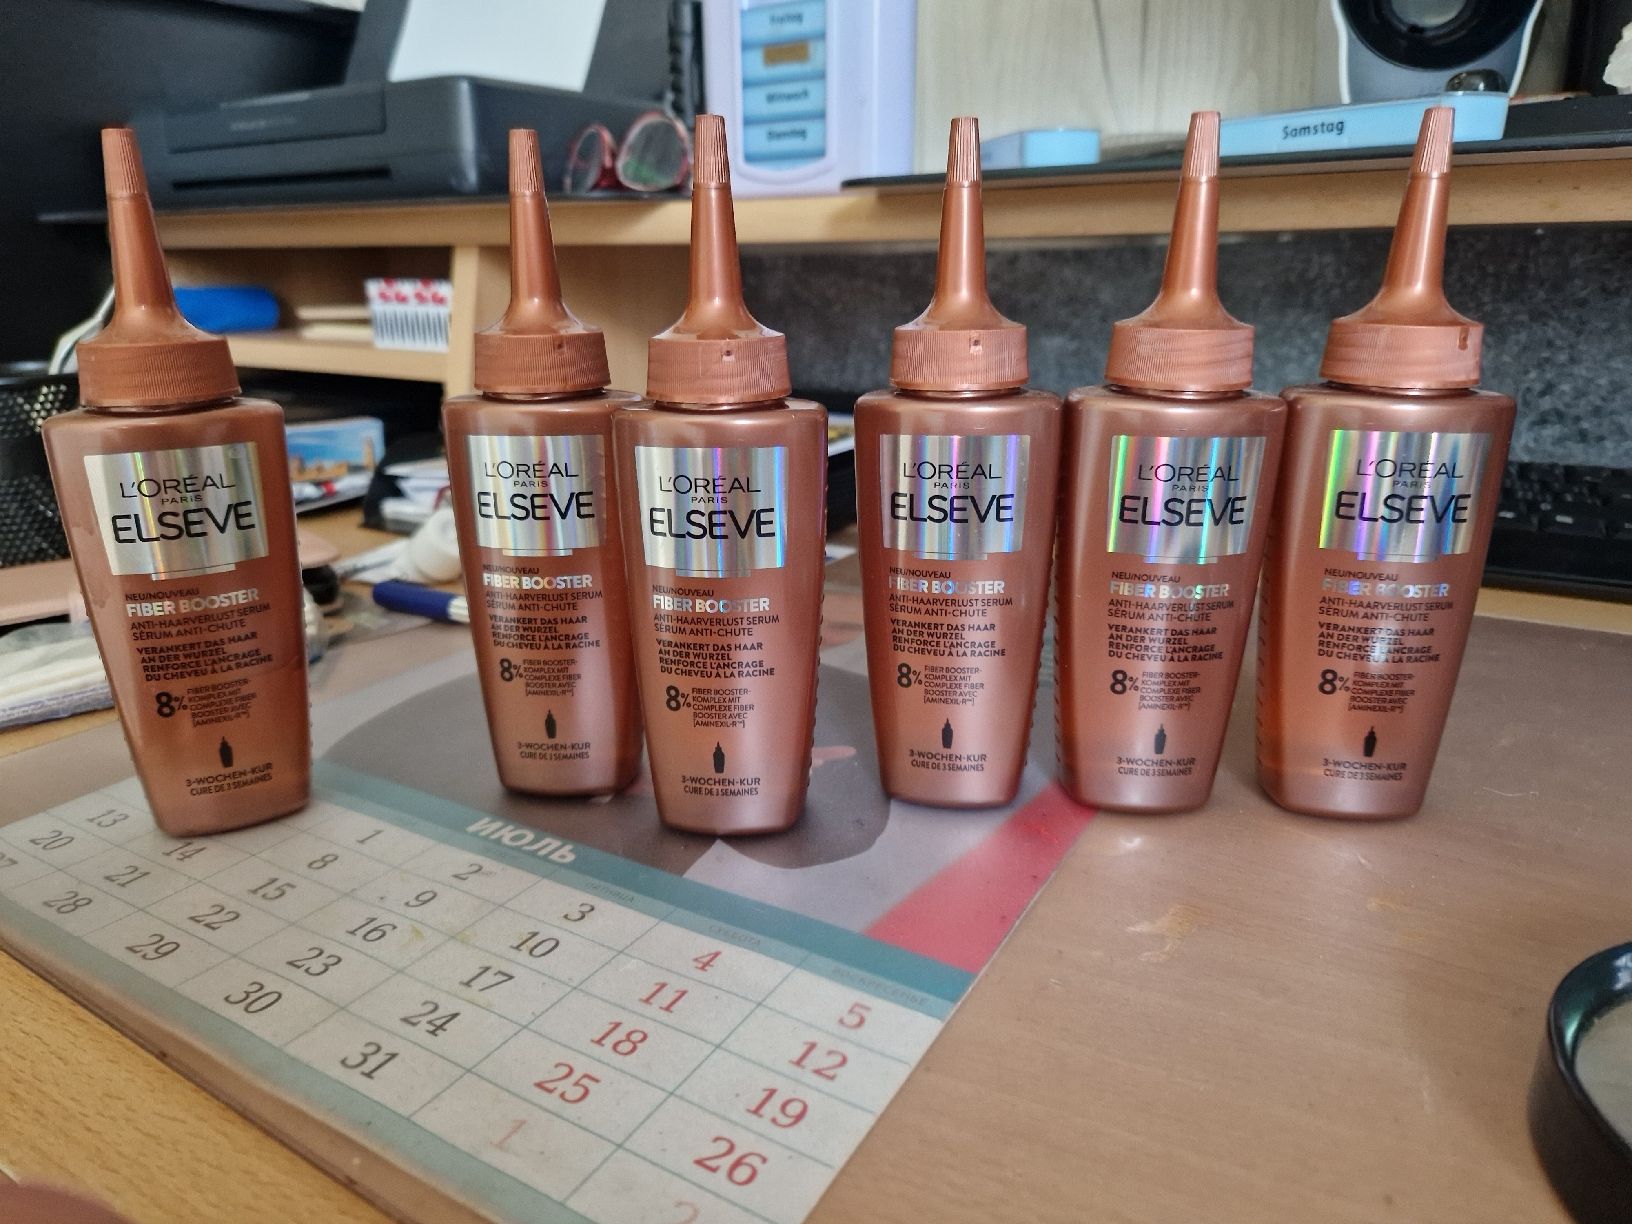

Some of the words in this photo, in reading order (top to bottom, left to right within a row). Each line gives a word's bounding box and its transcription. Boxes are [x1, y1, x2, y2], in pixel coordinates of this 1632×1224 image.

[1281, 120, 1345, 140] Samstag
[485, 457, 579, 480] L'ORÉAL
[903, 462, 1002, 479] L'ORÉAL
[1138, 463, 1239, 482] L'ORÉAL
[1356, 459, 1463, 478] L'ORÉAL
[120, 472, 236, 498] L'ORÉAL
[514, 479, 547, 488] PARIS
[659, 474, 760, 494] L'ORÉAL
[1172, 484, 1209, 492] PARIS
[1393, 480, 1431, 489] PARIS
[161, 495, 203, 505] PARIS
[476, 487, 594, 522] ELSEVE
[691, 496, 728, 504] PARIS
[1335, 490, 1472, 524] ELSEVE
[891, 492, 1014, 523] ELSEVE
[1119, 495, 1247, 527] ELSEVE
[111, 501, 256, 544] ELSEVE
[648, 506, 775, 538] ELSEVE
[482, 575, 520, 589] FIBER
[522, 573, 593, 590] BOOSTER
[889, 576, 928, 593] FIBER
[932, 580, 1004, 594] BOOSTER
[571, 590, 602, 600] SERUM
[1109, 581, 1156, 598] FIBER
[1159, 583, 1229, 600] BOOSTER
[126, 600, 177, 616] FIBER
[180, 588, 260, 612] BOOSTER
[518, 602, 577, 611] ANTI-CHUTE
[652, 595, 692, 612] FIBER
[695, 597, 770, 613] BOOSTER
[981, 598, 1013, 607] SERUM
[1207, 599, 1234, 610] SERUM
[1424, 600, 1453, 611] SERUM
[237, 603, 271, 618] SERUM
[924, 608, 987, 617] ANTI-CHUTE
[1149, 612, 1212, 622] ANTI-CHUTE
[1361, 611, 1429, 622] ANTI-CHUTE
[488, 615, 538, 624] VERANKERT
[560, 616, 587, 624] HAAR
[747, 615, 779, 625] SERUM
[891, 619, 944, 631] VERANKERT
[176, 619, 246, 639] ANTI-CHUTE
[689, 628, 753, 636] ANTI-CHUTE
[1107, 623, 1168, 636] VERANKERT
[1171, 628, 1190, 637] DAS
[1193, 627, 1217, 636] HAAR
[1407, 627, 1435, 637] HAAR
[136, 641, 202, 656] VERANKERT
[204, 637, 226, 648] DAS
[227, 631, 258, 644] HAAR
[656, 640, 710, 651] VERANKERT
[734, 642, 763, 651] HAAR
[658, 649, 671, 657] AN
[673, 650, 691, 659] DER
[693, 652, 732, 661] WURZEL
[659, 657, 707, 669] RENFORCE
[661, 666, 673, 674] DU
[674, 668, 712, 678] CHEVEU
[739, 668, 775, 678] RACINE
[516, 739, 591, 752] 3-WOCHEN-KUR
[909, 749, 987, 762] 3-WOCHEN-KUR
[1117, 756, 1197, 767] 3-WOCHEN-KUR
[1324, 759, 1408, 769] 3-WOCHEN-KUR
[185, 762, 273, 788] 3-WOCHEN-KUR
[681, 774, 760, 786] 3-WOCHEN-KUR
[684, 785, 702, 795] CURE
[704, 787, 713, 796] DE
[721, 787, 758, 796] SEMAINES
[466, 817, 576, 863] ИЮЛЬ
[356, 829, 384, 845] 1
[452, 863, 484, 881] 2
[563, 903, 595, 923] 3
[692, 950, 722, 972] 4
[838, 1001, 872, 1030] 5
[87, 809, 129, 828] 13
[162, 841, 207, 862] 14
[248, 877, 296, 901] 15
[345, 917, 397, 942] 16
[459, 965, 515, 992] 17
[590, 1021, 648, 1056] 18
[746, 1087, 808, 1129] 19
[307, 853, 339, 870] 8
[404, 890, 438, 908] 9
[510, 931, 560, 958] 10
[639, 981, 689, 1014] 11
[788, 1040, 848, 1081] 12
[29, 830, 74, 850] 20
[104, 865, 151, 888] 21
[187, 903, 240, 931] 22
[286, 947, 343, 977] 23
[400, 1000, 461, 1037] 24
[533, 1061, 601, 1105] 25
[692, 1135, 768, 1187] 26
[42, 890, 93, 914] 28
[125, 933, 180, 961] 29
[224, 981, 283, 1014] 30
[340, 1041, 399, 1080] 31
[490, 1118, 527, 1150] 1
